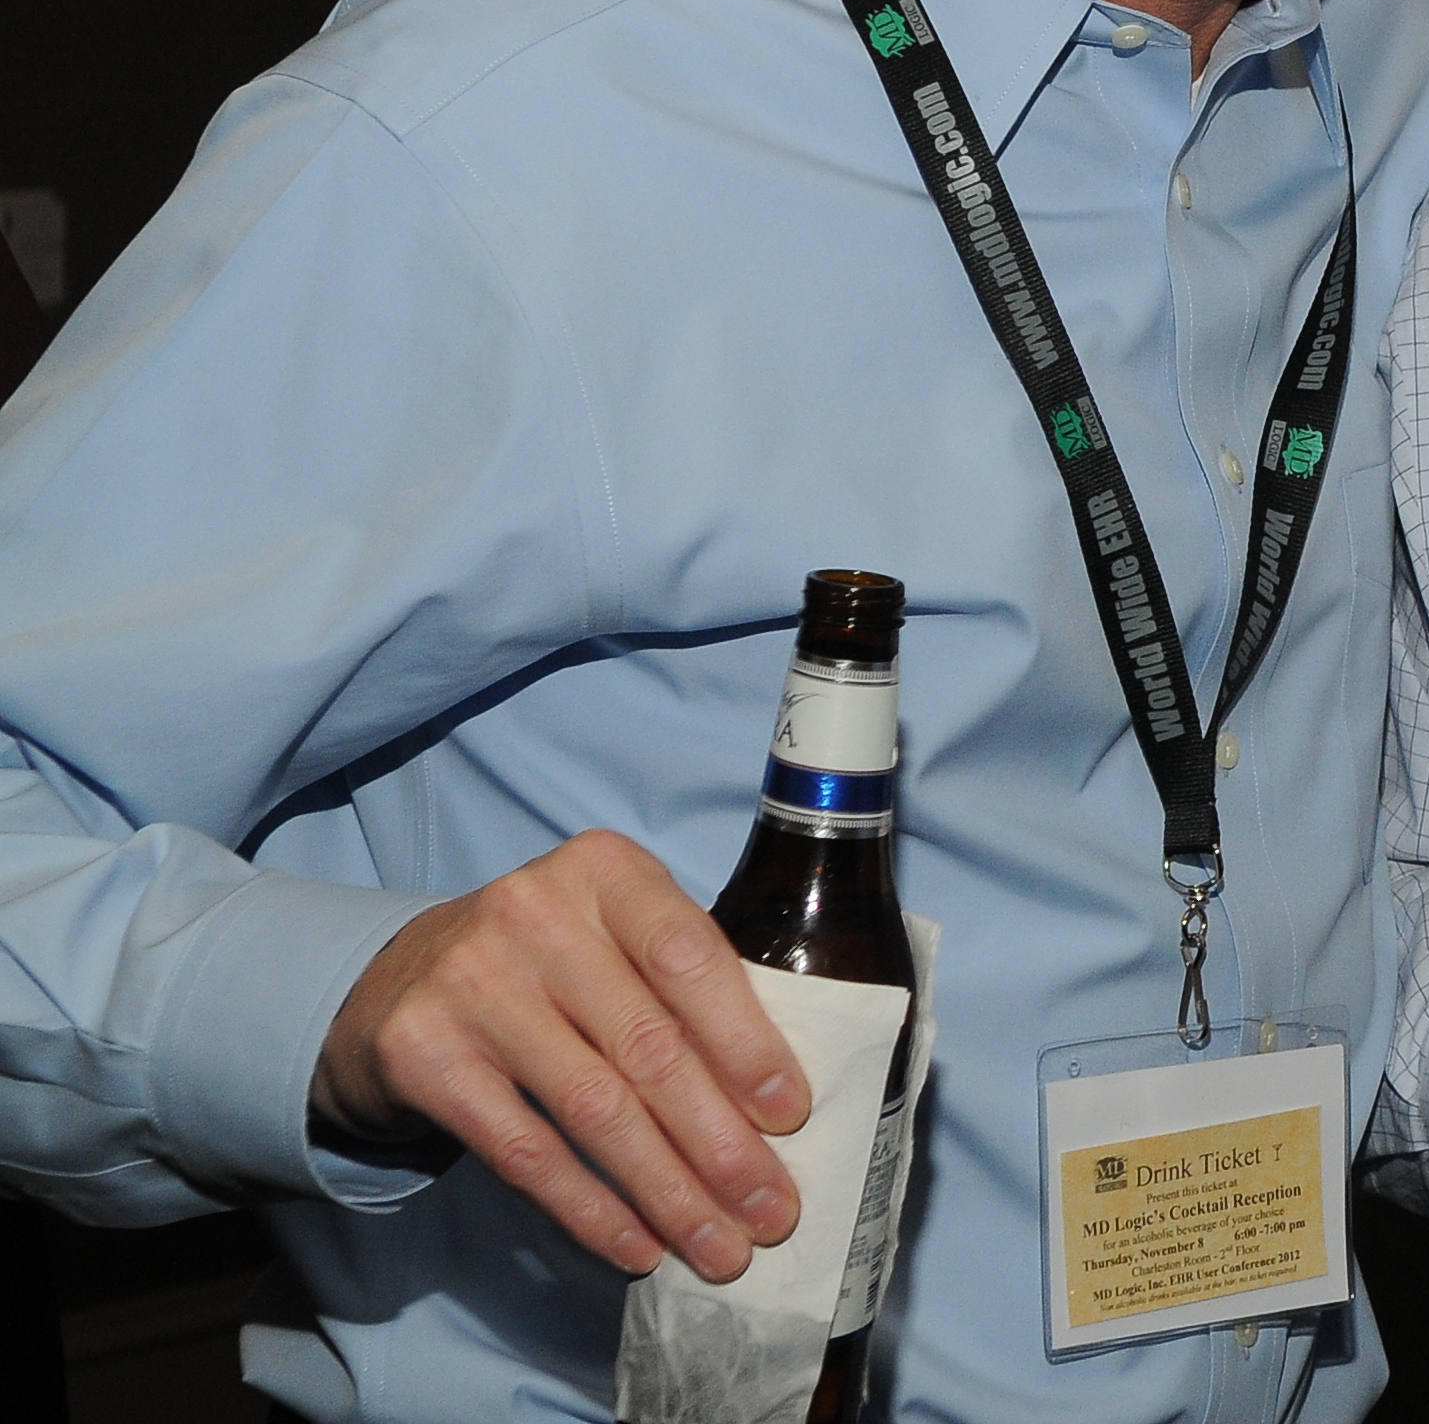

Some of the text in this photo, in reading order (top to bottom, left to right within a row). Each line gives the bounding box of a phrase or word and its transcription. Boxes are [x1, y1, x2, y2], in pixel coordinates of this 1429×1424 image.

[904, 3, 930, 40] LOGIC
[913, 80, 1061, 372] www.mdlogic.com
[1058, 410, 1092, 455] MD
[1079, 402, 1106, 449] LOGIC
[1266, 425, 1285, 470] LOGIC
[1289, 430, 1316, 476] MD
[1257, 507, 1296, 605] World
[1088, 488, 1186, 745] World Wide EHR
[1135, 1158, 1193, 1188] Drink
[1199, 1145, 1262, 1175] Ticket
[1082, 1219, 1110, 1239] MD
[1168, 1196, 1229, 1221] Cocktail
[1233, 1185, 1302, 1209] Reception
[1146, 1178, 1239, 1204] Present this ticket at
[1082, 1253, 1138, 1273] Thursday,
[1140, 1240, 1196, 1261] November
[1197, 1237, 1205, 1249] 8
[1234, 1227, 1257, 1241] 6:00
[1289, 1219, 1306, 1234] pm
[1102, 1207, 1285, 1252] for an alcoholic beverage of your choice
[1093, 1249, 1301, 1302] MD Logic, Inc. EHR User Conference 2012
[1131, 1258, 1181, 1278] Charleston
[1183, 1253, 1212, 1269] Room
[1235, 1244, 1261, 1257] Floor
